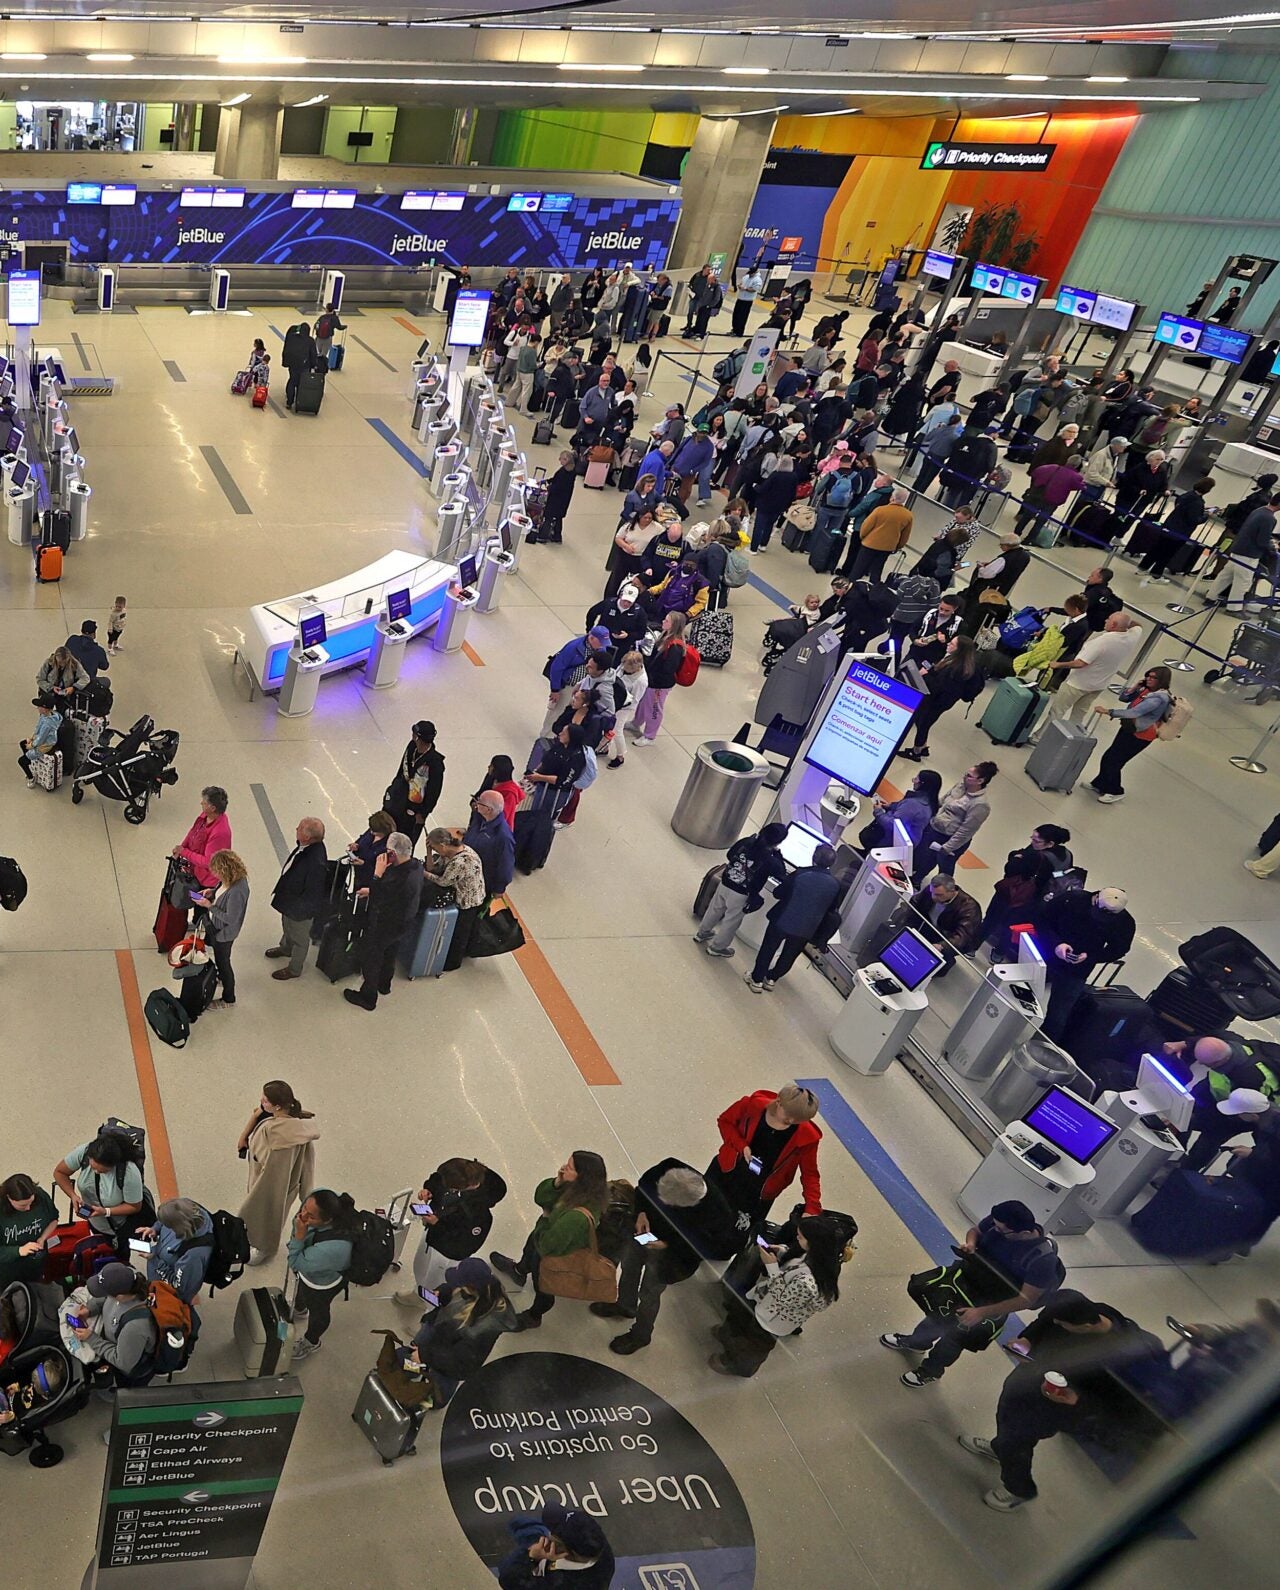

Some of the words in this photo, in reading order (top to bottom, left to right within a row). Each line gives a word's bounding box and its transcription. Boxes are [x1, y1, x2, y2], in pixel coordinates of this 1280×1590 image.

[958, 151, 993, 165] Priority
[993, 152, 1048, 166] Checkpoint
[176, 228, 225, 246] jetBlue
[390, 234, 447, 255] jetBlue
[585, 232, 642, 253] jetBlue
[852, 666, 890, 691] jetBlue
[845, 686, 869, 704] Start
[870, 698, 892, 716] here
[831, 714, 866, 737] Comenzar
[470, 1408, 562, 1432] Parking
[570, 1405, 652, 1430] Central
[155, 1432, 201, 1442] Priority
[205, 1426, 278, 1439] Checkpoint
[153, 1446, 186, 1456] Cape
[189, 1445, 208, 1453] Air
[489, 1442, 515, 1461] to
[523, 1432, 613, 1461] upstairs
[620, 1433, 658, 1455] Go
[151, 1459, 190, 1469] Etihad
[193, 1456, 243, 1466] Airways
[148, 1471, 195, 1481] JetBlue
[474, 1477, 609, 1517] Pickup
[619, 1474, 721, 1511] Uber
[143, 1506, 191, 1517] Security
[194, 1502, 262, 1514] Checkpoint
[140, 1520, 164, 1528] TSA
[167, 1516, 224, 1526] PreCheck
[139, 1532, 159, 1540] Aer
[162, 1529, 201, 1539] Lingus
[135, 1553, 158, 1561] TAP
[161, 1550, 208, 1560] Portugal
[136, 1541, 180, 1551] JetBlue
